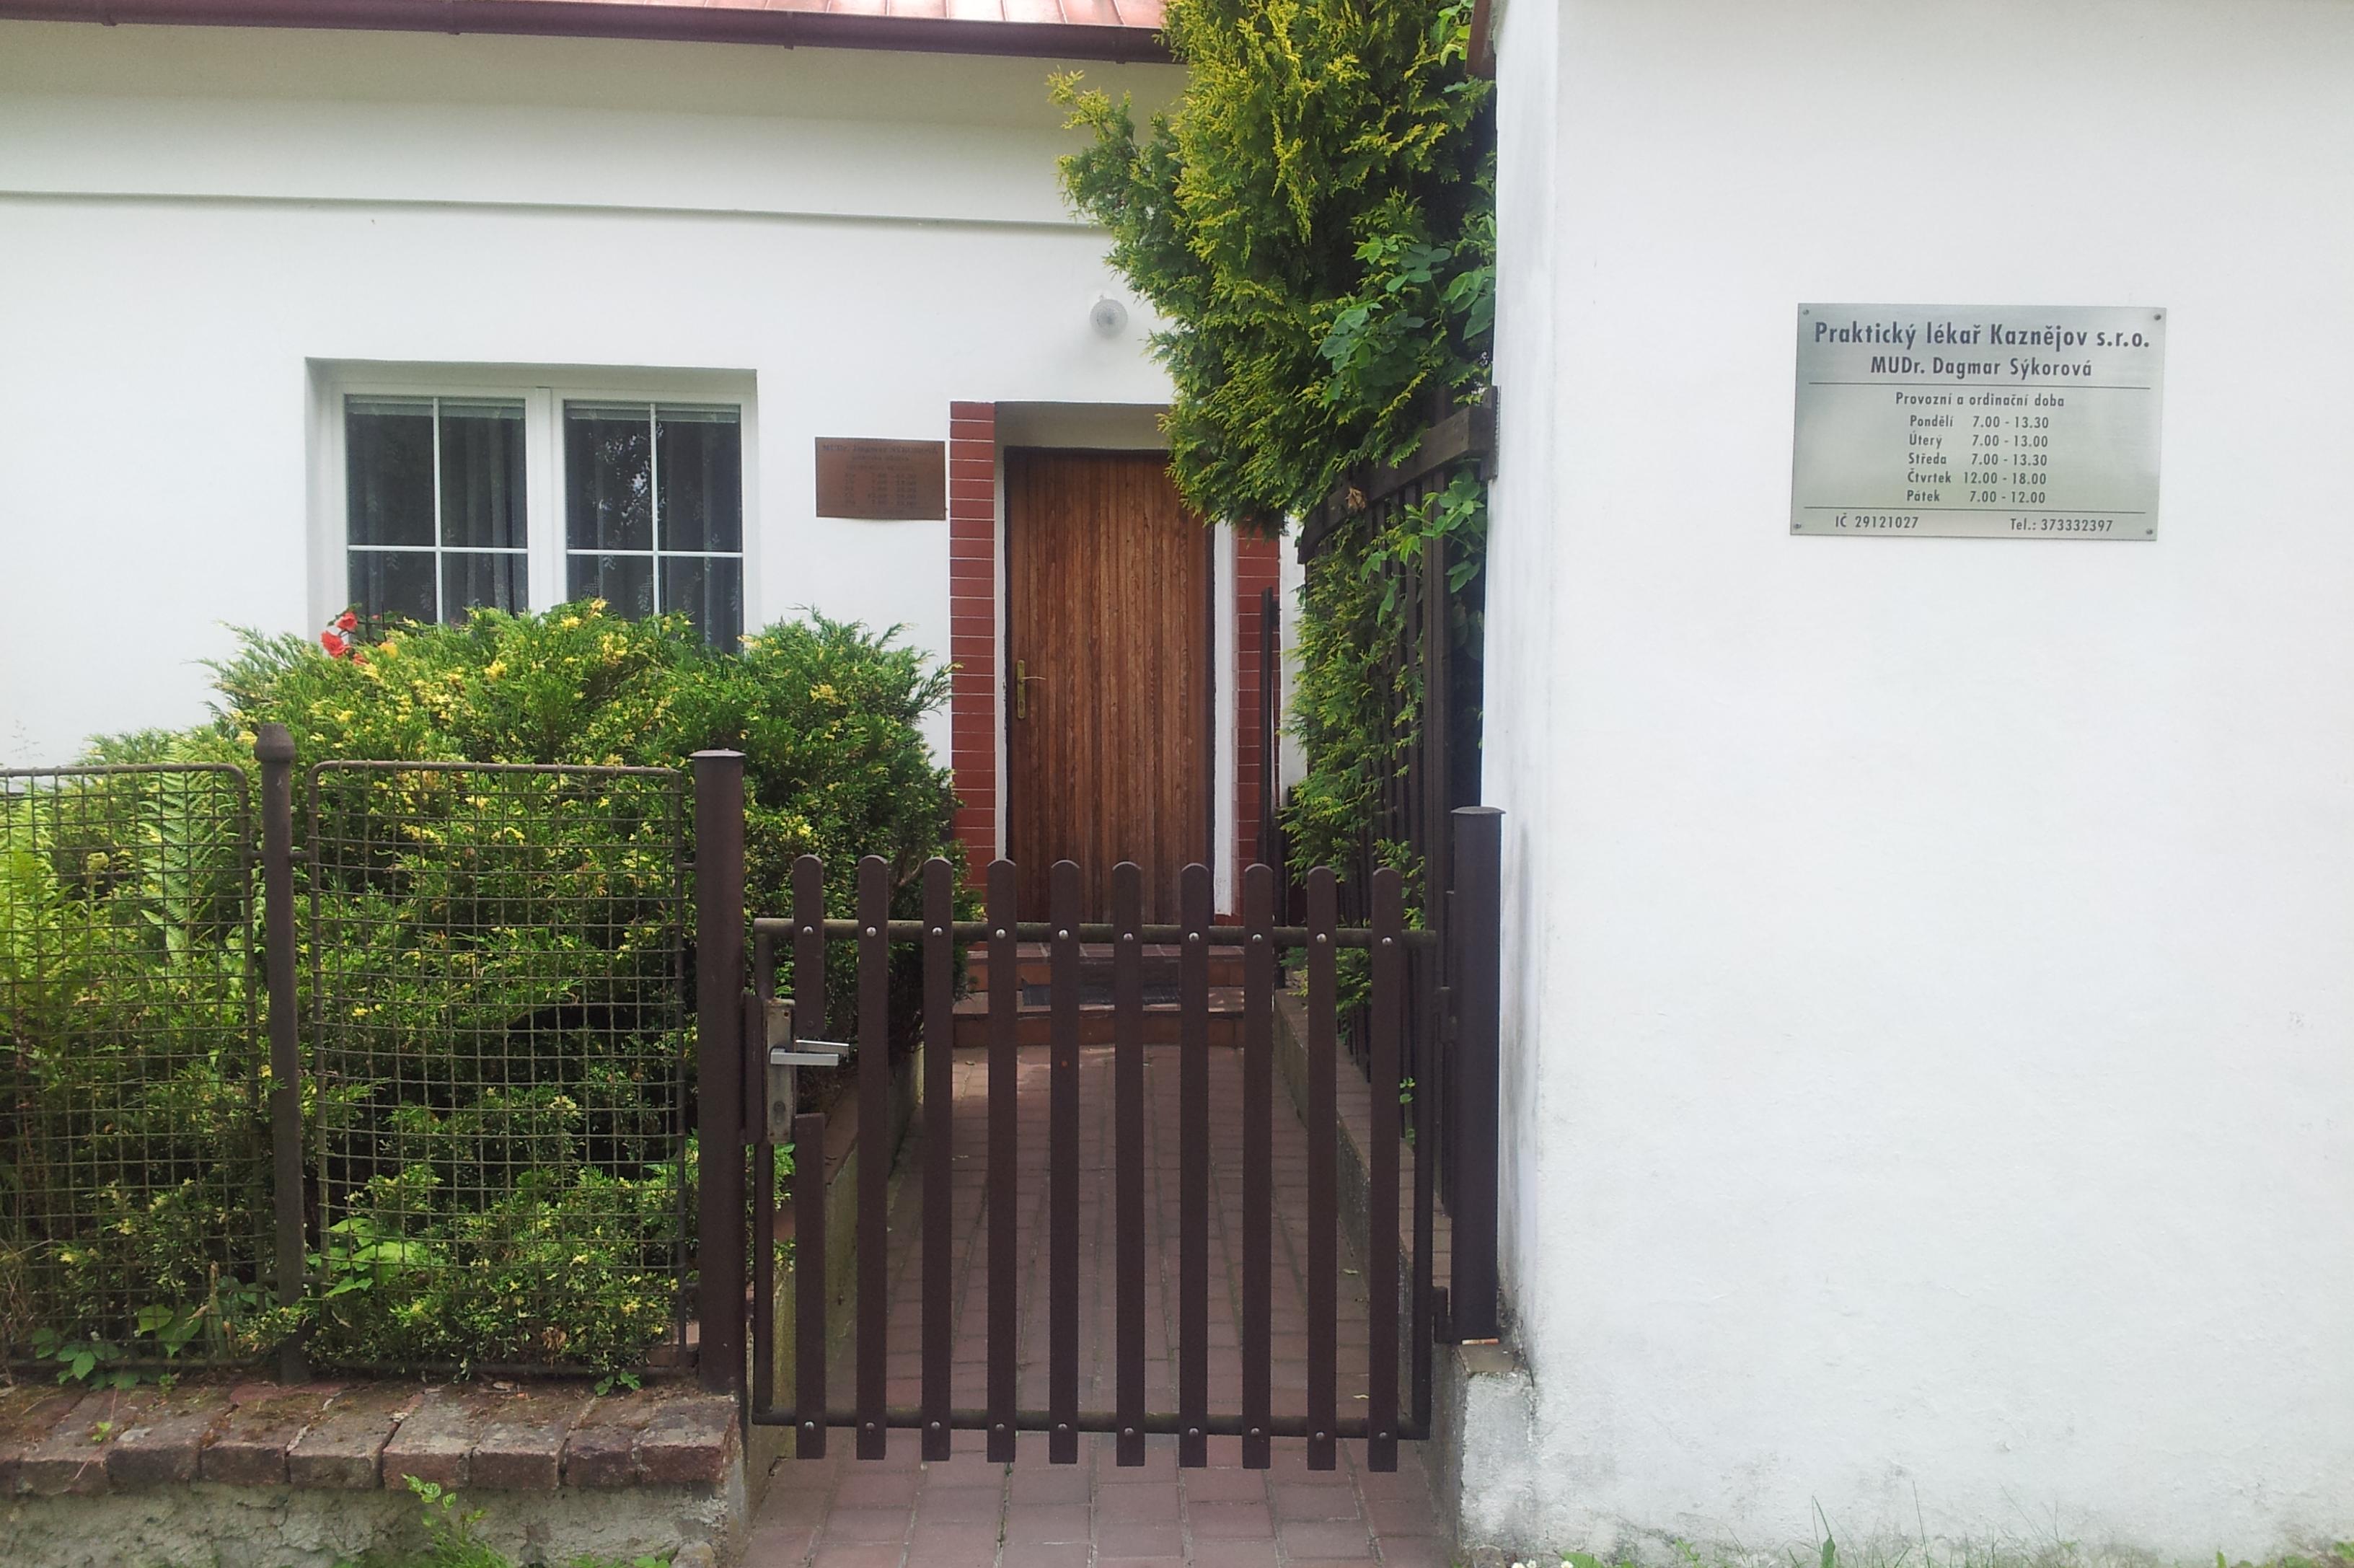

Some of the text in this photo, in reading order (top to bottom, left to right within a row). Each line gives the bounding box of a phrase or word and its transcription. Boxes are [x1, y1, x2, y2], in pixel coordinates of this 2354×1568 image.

[1816, 321, 2149, 352] Praktický lékař Kaznějov s.r.o.
[1871, 356, 2091, 380] MUDr. Dagmar Sýkorová
[1896, 392, 1952, 405] Provozní
[1970, 392, 2028, 406] ordinační
[2035, 393, 2064, 406] doba
[1910, 414, 1953, 427] Pondělí
[1973, 415, 2000, 428] 7.00
[2016, 416, 2048, 428] 13.30
[1910, 431, 1942, 449] Úterý
[1972, 434, 1999, 446] 7.00
[2014, 435, 2047, 447] 13.00
[1909, 452, 1947, 464] Středa
[1972, 453, 1998, 465] 7.00
[2014, 454, 2047, 466] 13.30
[1908, 468, 1951, 483] Čtvrtek
[1965, 472, 1997, 484] 12.00
[2013, 472, 2046, 485] 18.00
[1907, 489, 1939, 502] Pátek
[1970, 490, 1996, 503] 7.00
[2011, 491, 2045, 503] 12.00
[1835, 513, 1918, 528] IČ 29121027
[2011, 518, 2113, 532] Tel.: 373332397
